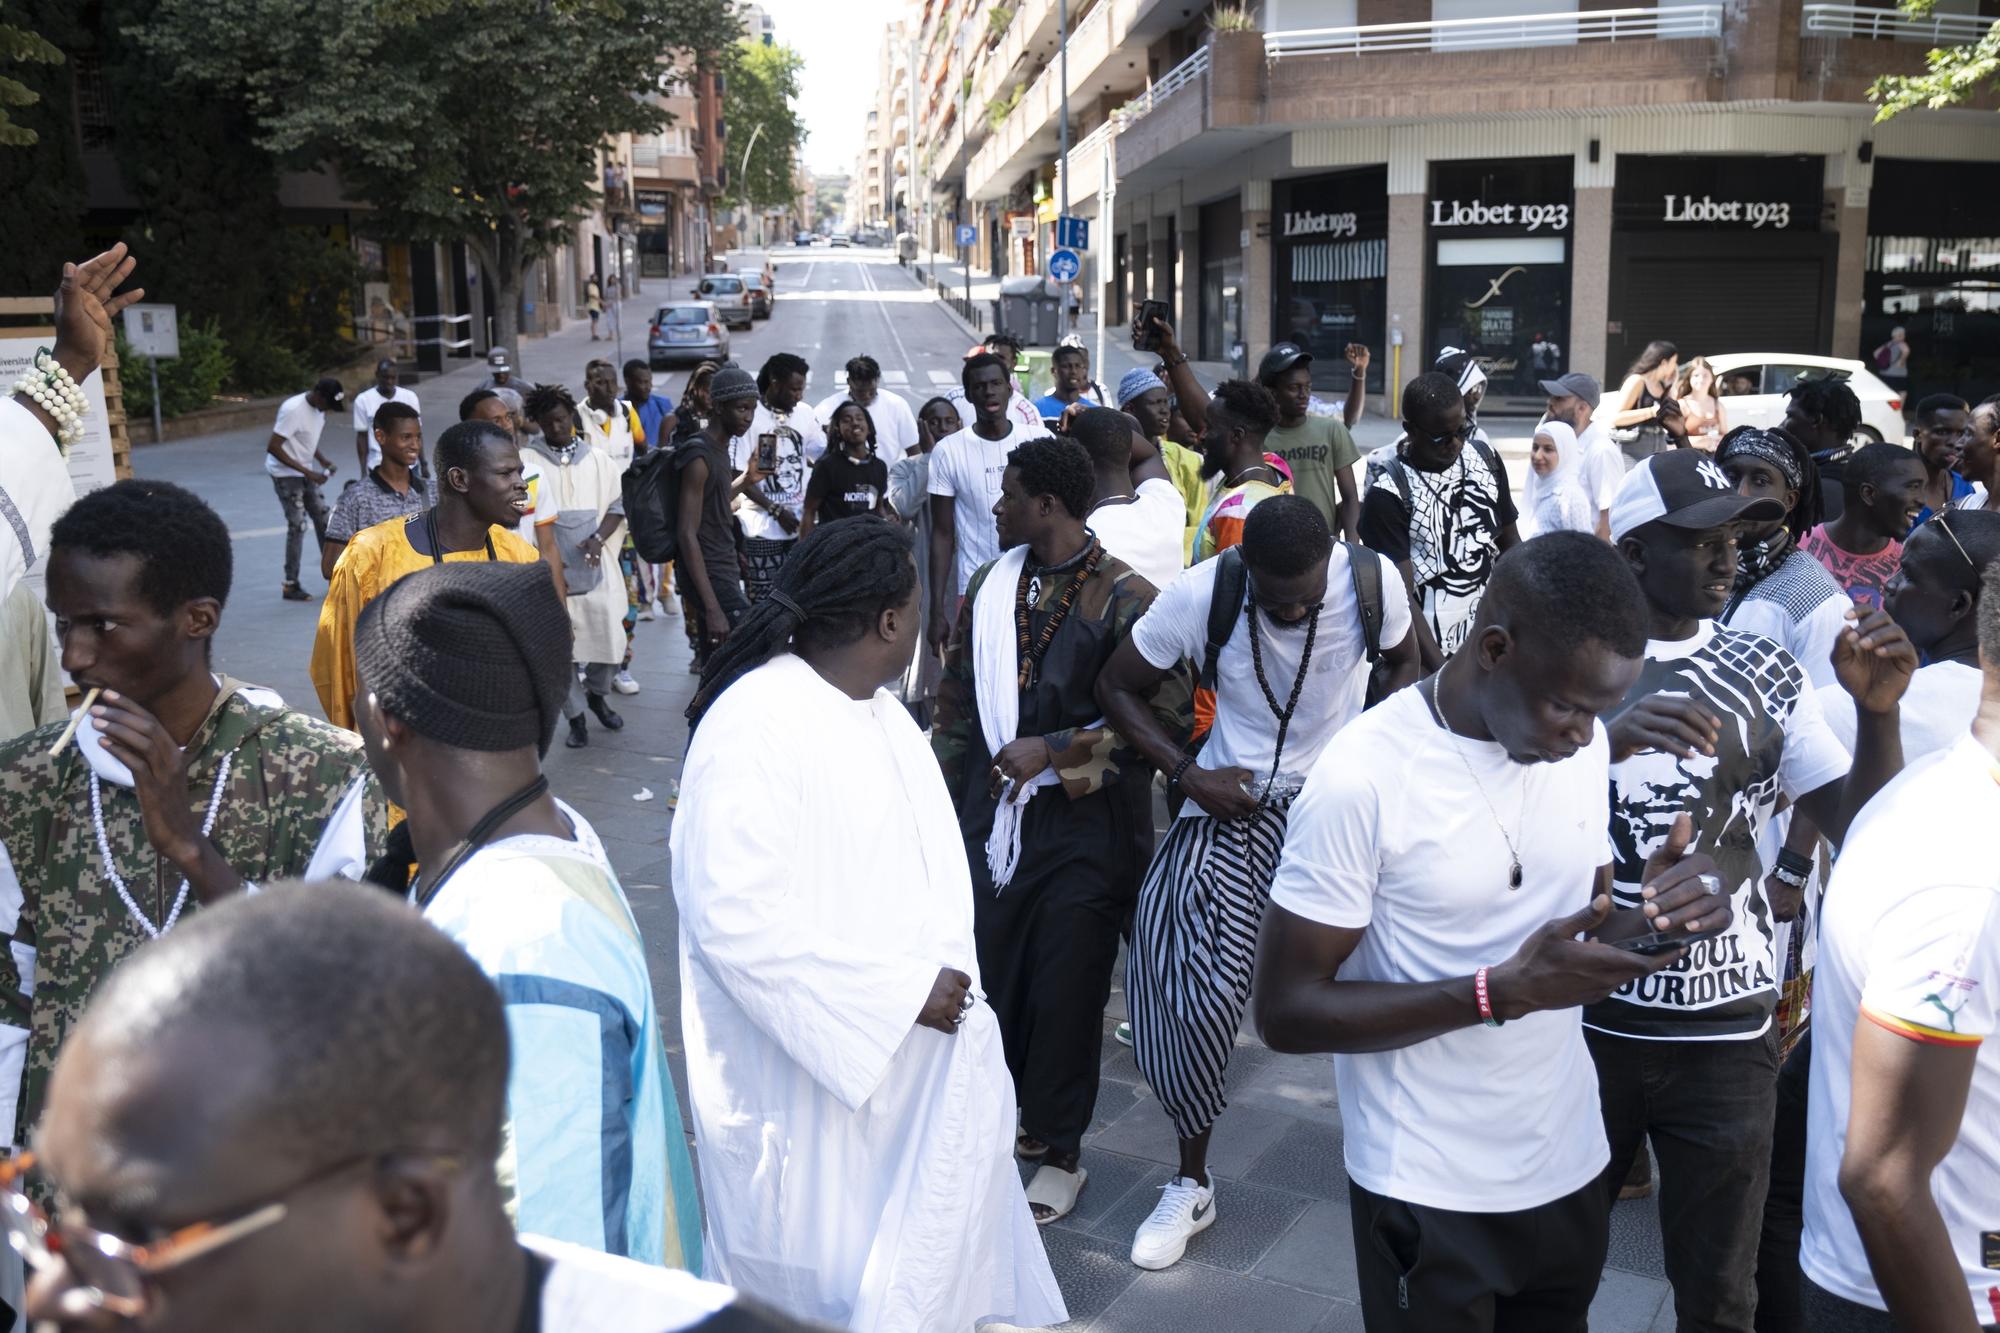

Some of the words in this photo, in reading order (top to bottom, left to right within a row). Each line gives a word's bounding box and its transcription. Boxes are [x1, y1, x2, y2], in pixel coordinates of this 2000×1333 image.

[1283, 210, 1328, 236] Llobet
[1328, 212, 1357, 238] 1923
[1430, 199, 1515, 226] Llobet
[1519, 204, 1569, 231] 1923
[1663, 194, 1741, 222] Llobet
[1744, 202, 1790, 229] 1923
[1274, 444, 1328, 465] RASHER
[1695, 460, 1731, 490] NY
[1665, 934, 1746, 973] BOUL
[1614, 960, 1775, 1006] OURIDINA
